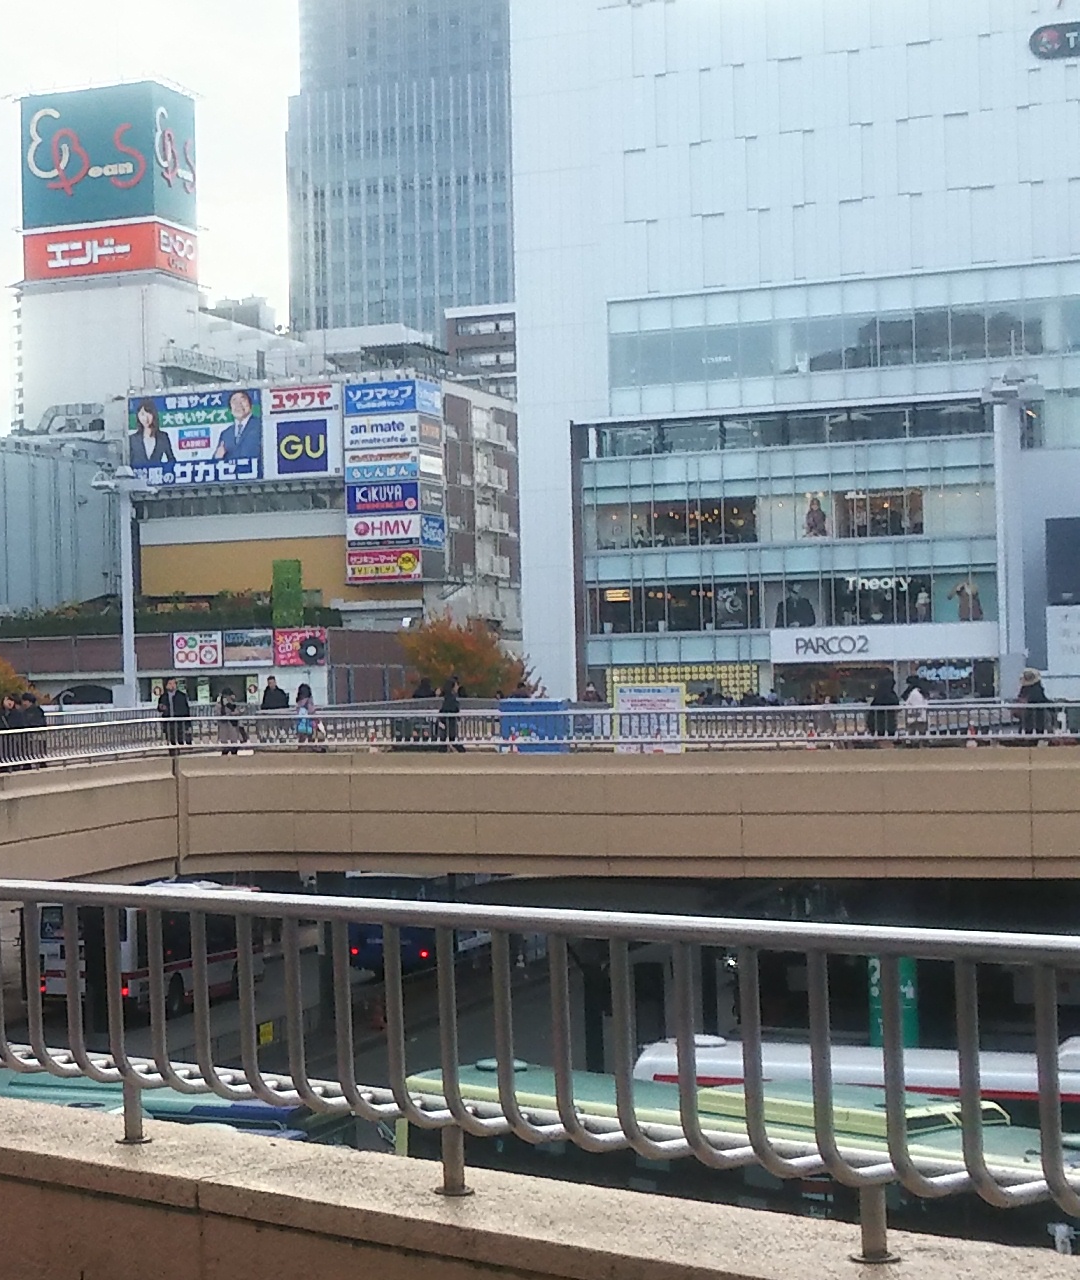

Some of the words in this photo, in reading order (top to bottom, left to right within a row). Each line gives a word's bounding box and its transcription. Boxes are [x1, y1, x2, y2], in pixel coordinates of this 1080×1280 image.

[46, 238, 131, 269] エンドー
[347, 385, 413, 402] ソフマップ
[162, 410, 228, 426] 大きいサイズ
[350, 419, 405, 435] animate
[279, 434, 325, 460] GU
[371, 519, 412, 536] HMV
[845, 576, 912, 593] Theory
